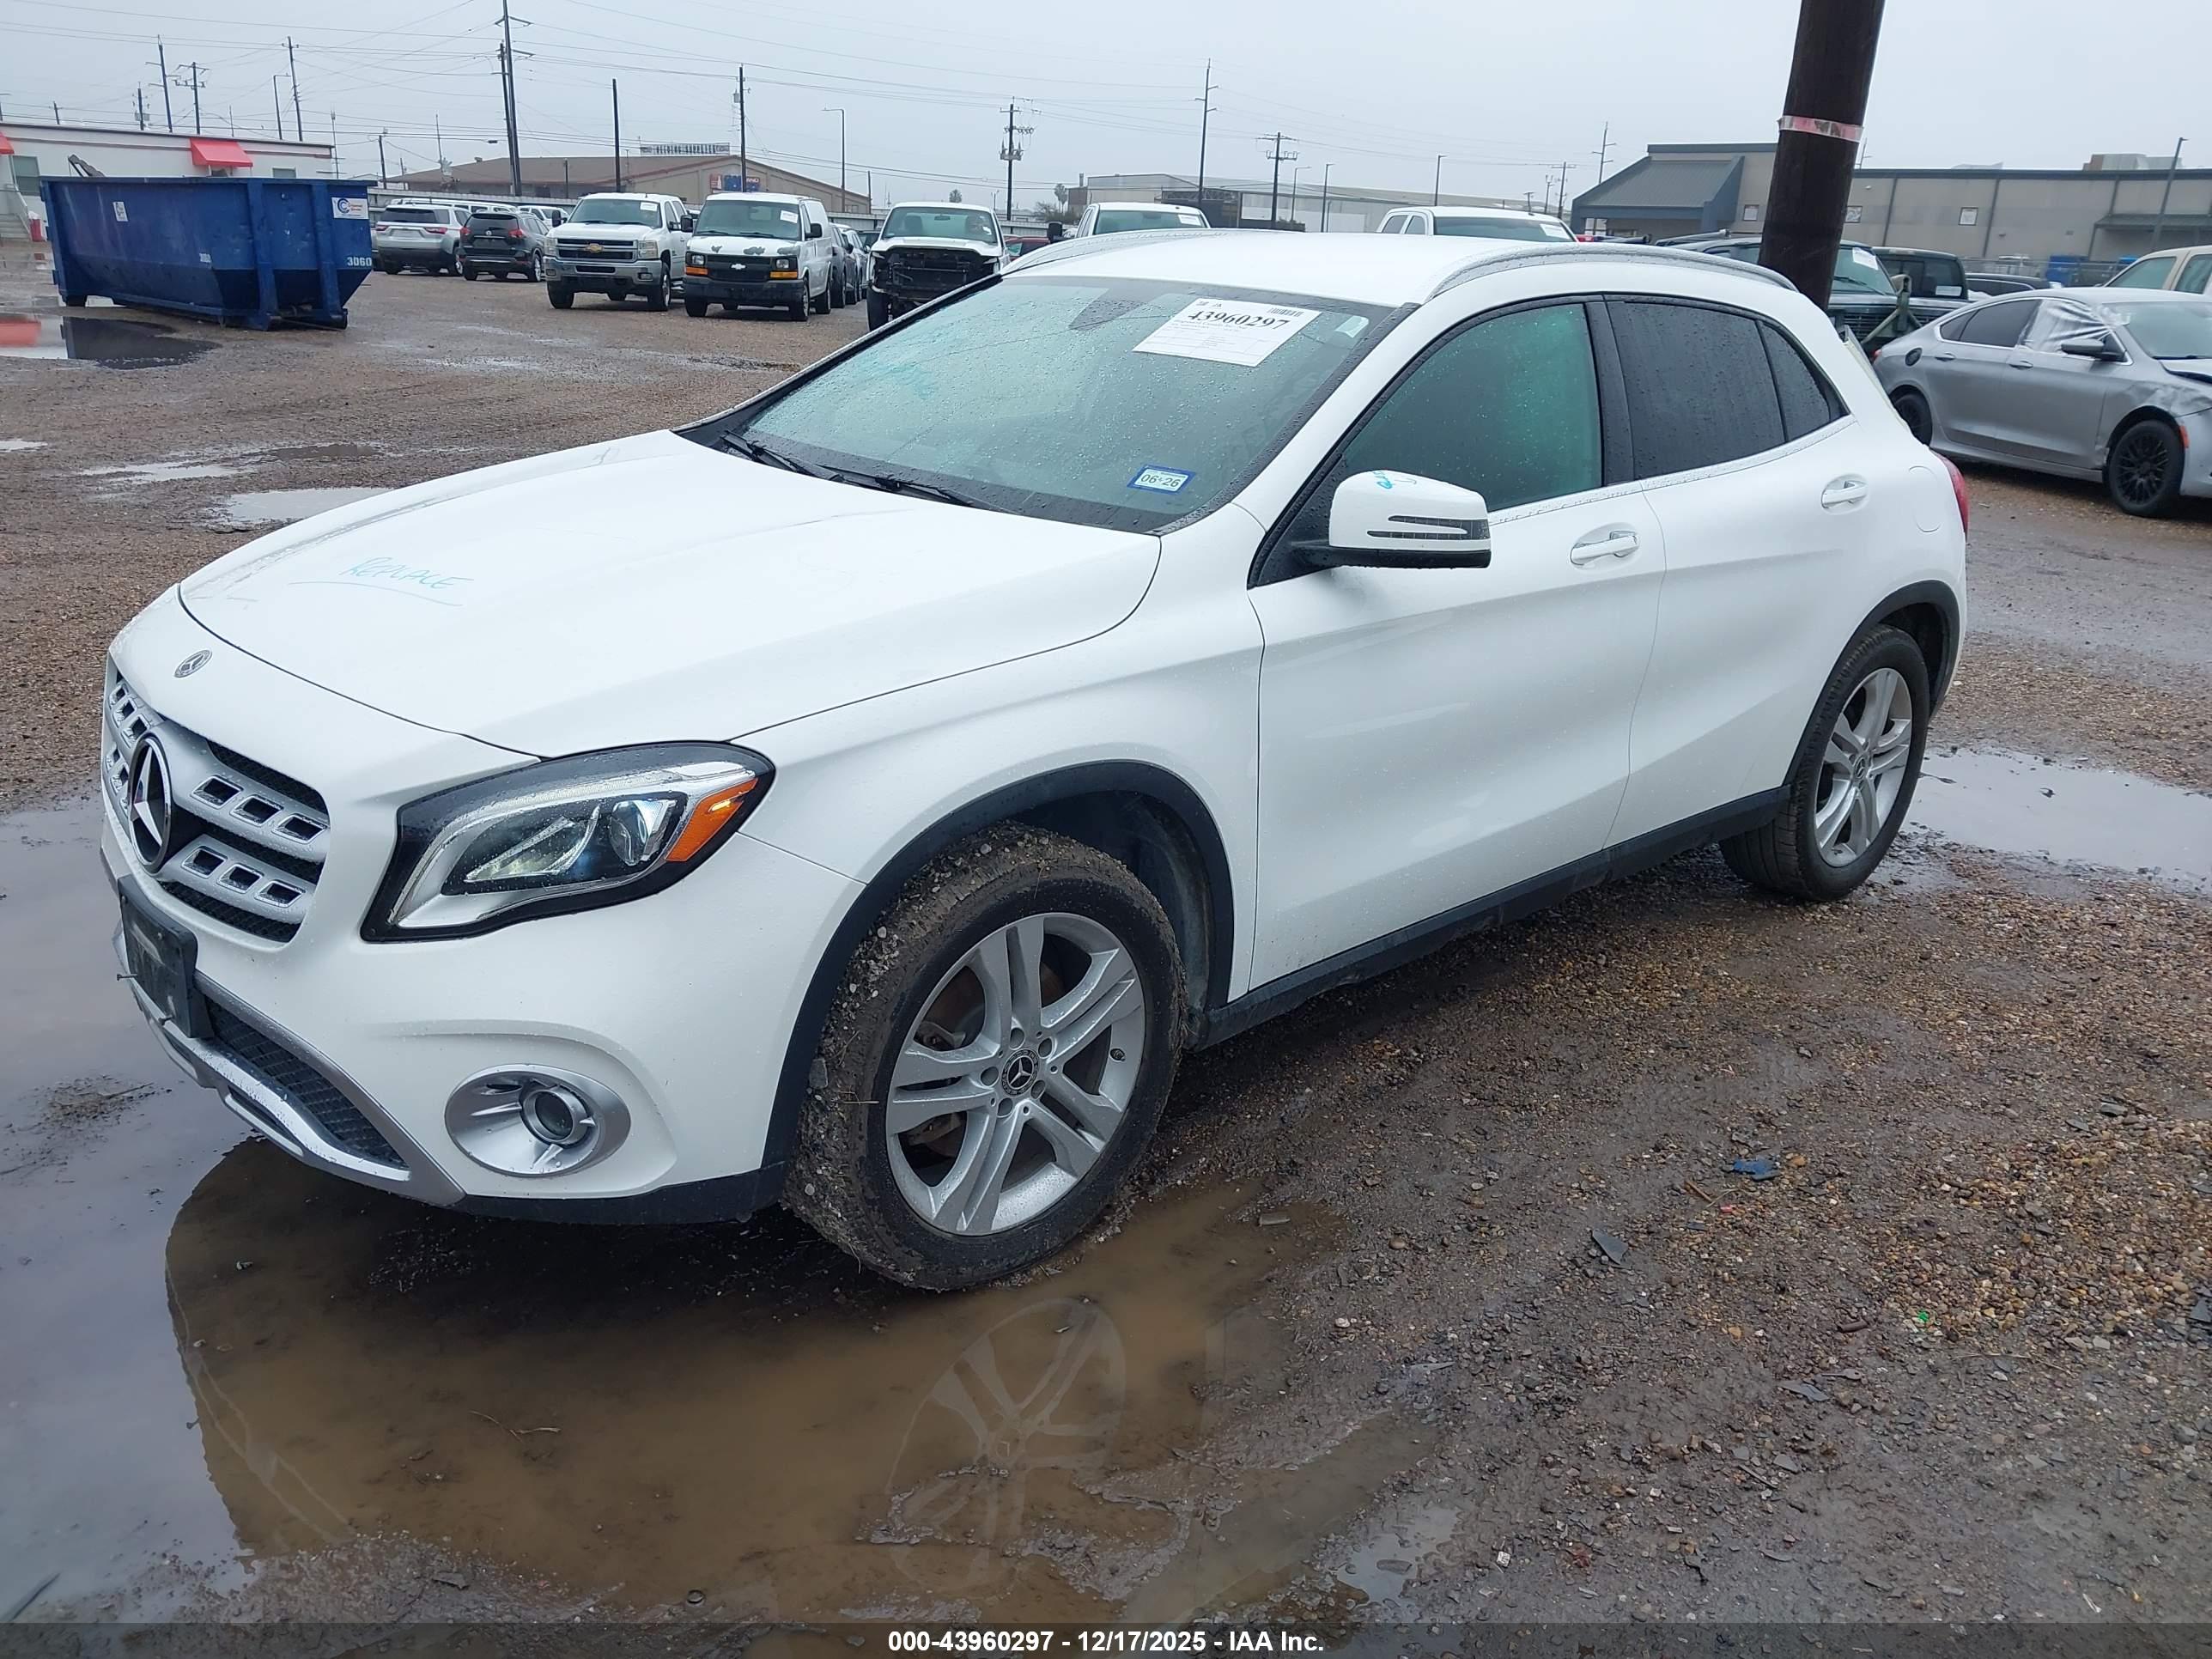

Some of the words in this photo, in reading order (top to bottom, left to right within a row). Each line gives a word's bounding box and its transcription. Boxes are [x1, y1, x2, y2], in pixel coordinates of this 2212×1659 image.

[1188, 310, 1291, 329] 43960297
[1140, 474, 1159, 483] 06
[1162, 477, 1182, 488] 26
